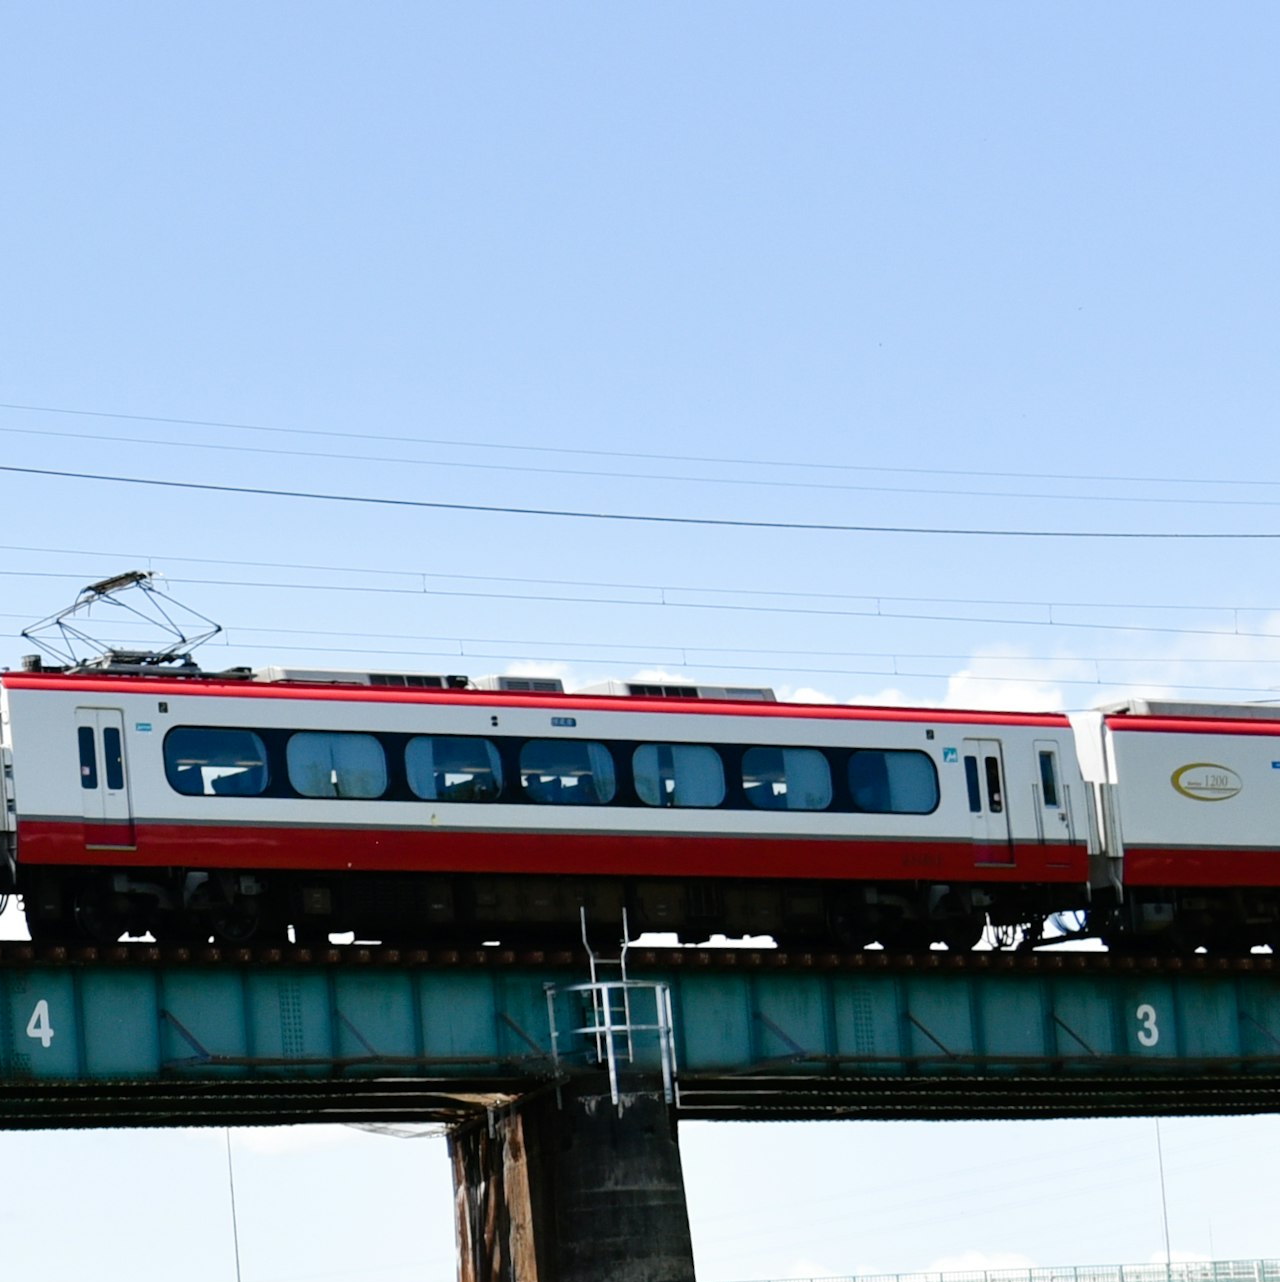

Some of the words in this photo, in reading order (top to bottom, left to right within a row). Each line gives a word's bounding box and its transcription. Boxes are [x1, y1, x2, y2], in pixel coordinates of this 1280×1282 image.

[1205, 775, 1228, 786] 1200
[26, 1000, 54, 1047] 4
[1136, 1004, 1159, 1046] 3
